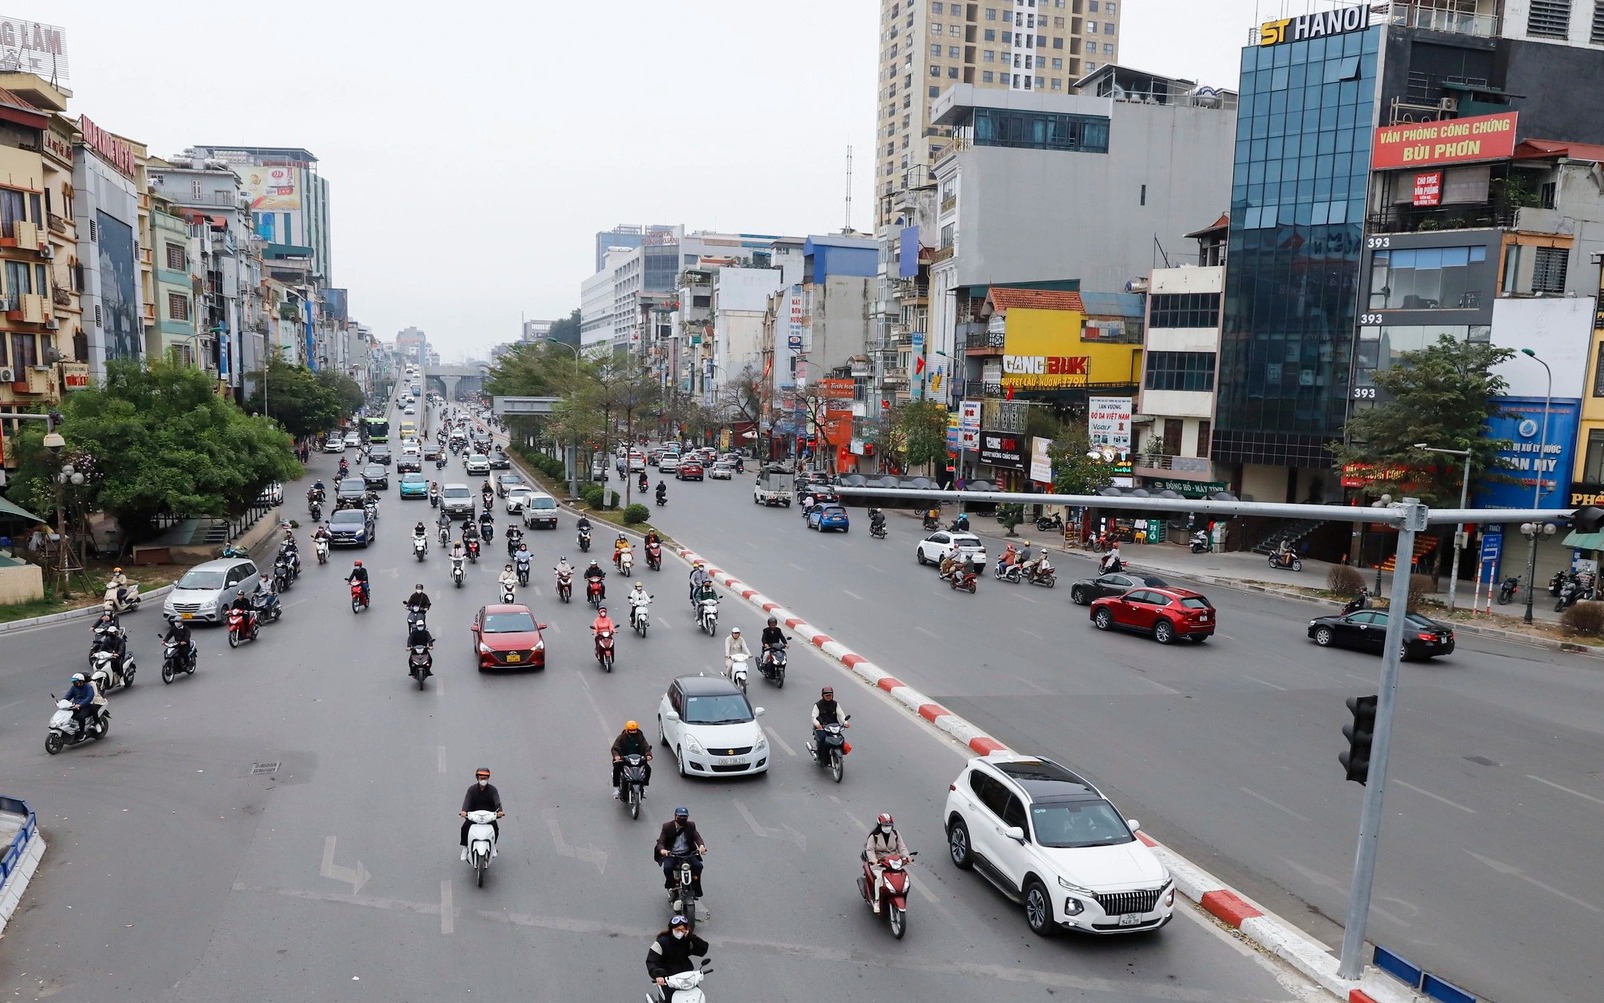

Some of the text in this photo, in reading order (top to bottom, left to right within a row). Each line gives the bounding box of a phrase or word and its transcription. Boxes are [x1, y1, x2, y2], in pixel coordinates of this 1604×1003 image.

[1260, 4, 1369, 46] ST HANOI
[1380, 118, 1511, 144] VĂN PHÒNG CÔNG CHỨNG
[1403, 140, 1481, 162] BÙI PHƠN
[1367, 238, 1390, 249] 393
[1360, 314, 1383, 324] 393
[1003, 355, 1088, 375] GANG BUK
[1353, 388, 1375, 398] 393
[1118, 413, 1130, 421] NAM
[1513, 443, 1521, 453] BỊ
[1533, 441, 1541, 453] LÝ
